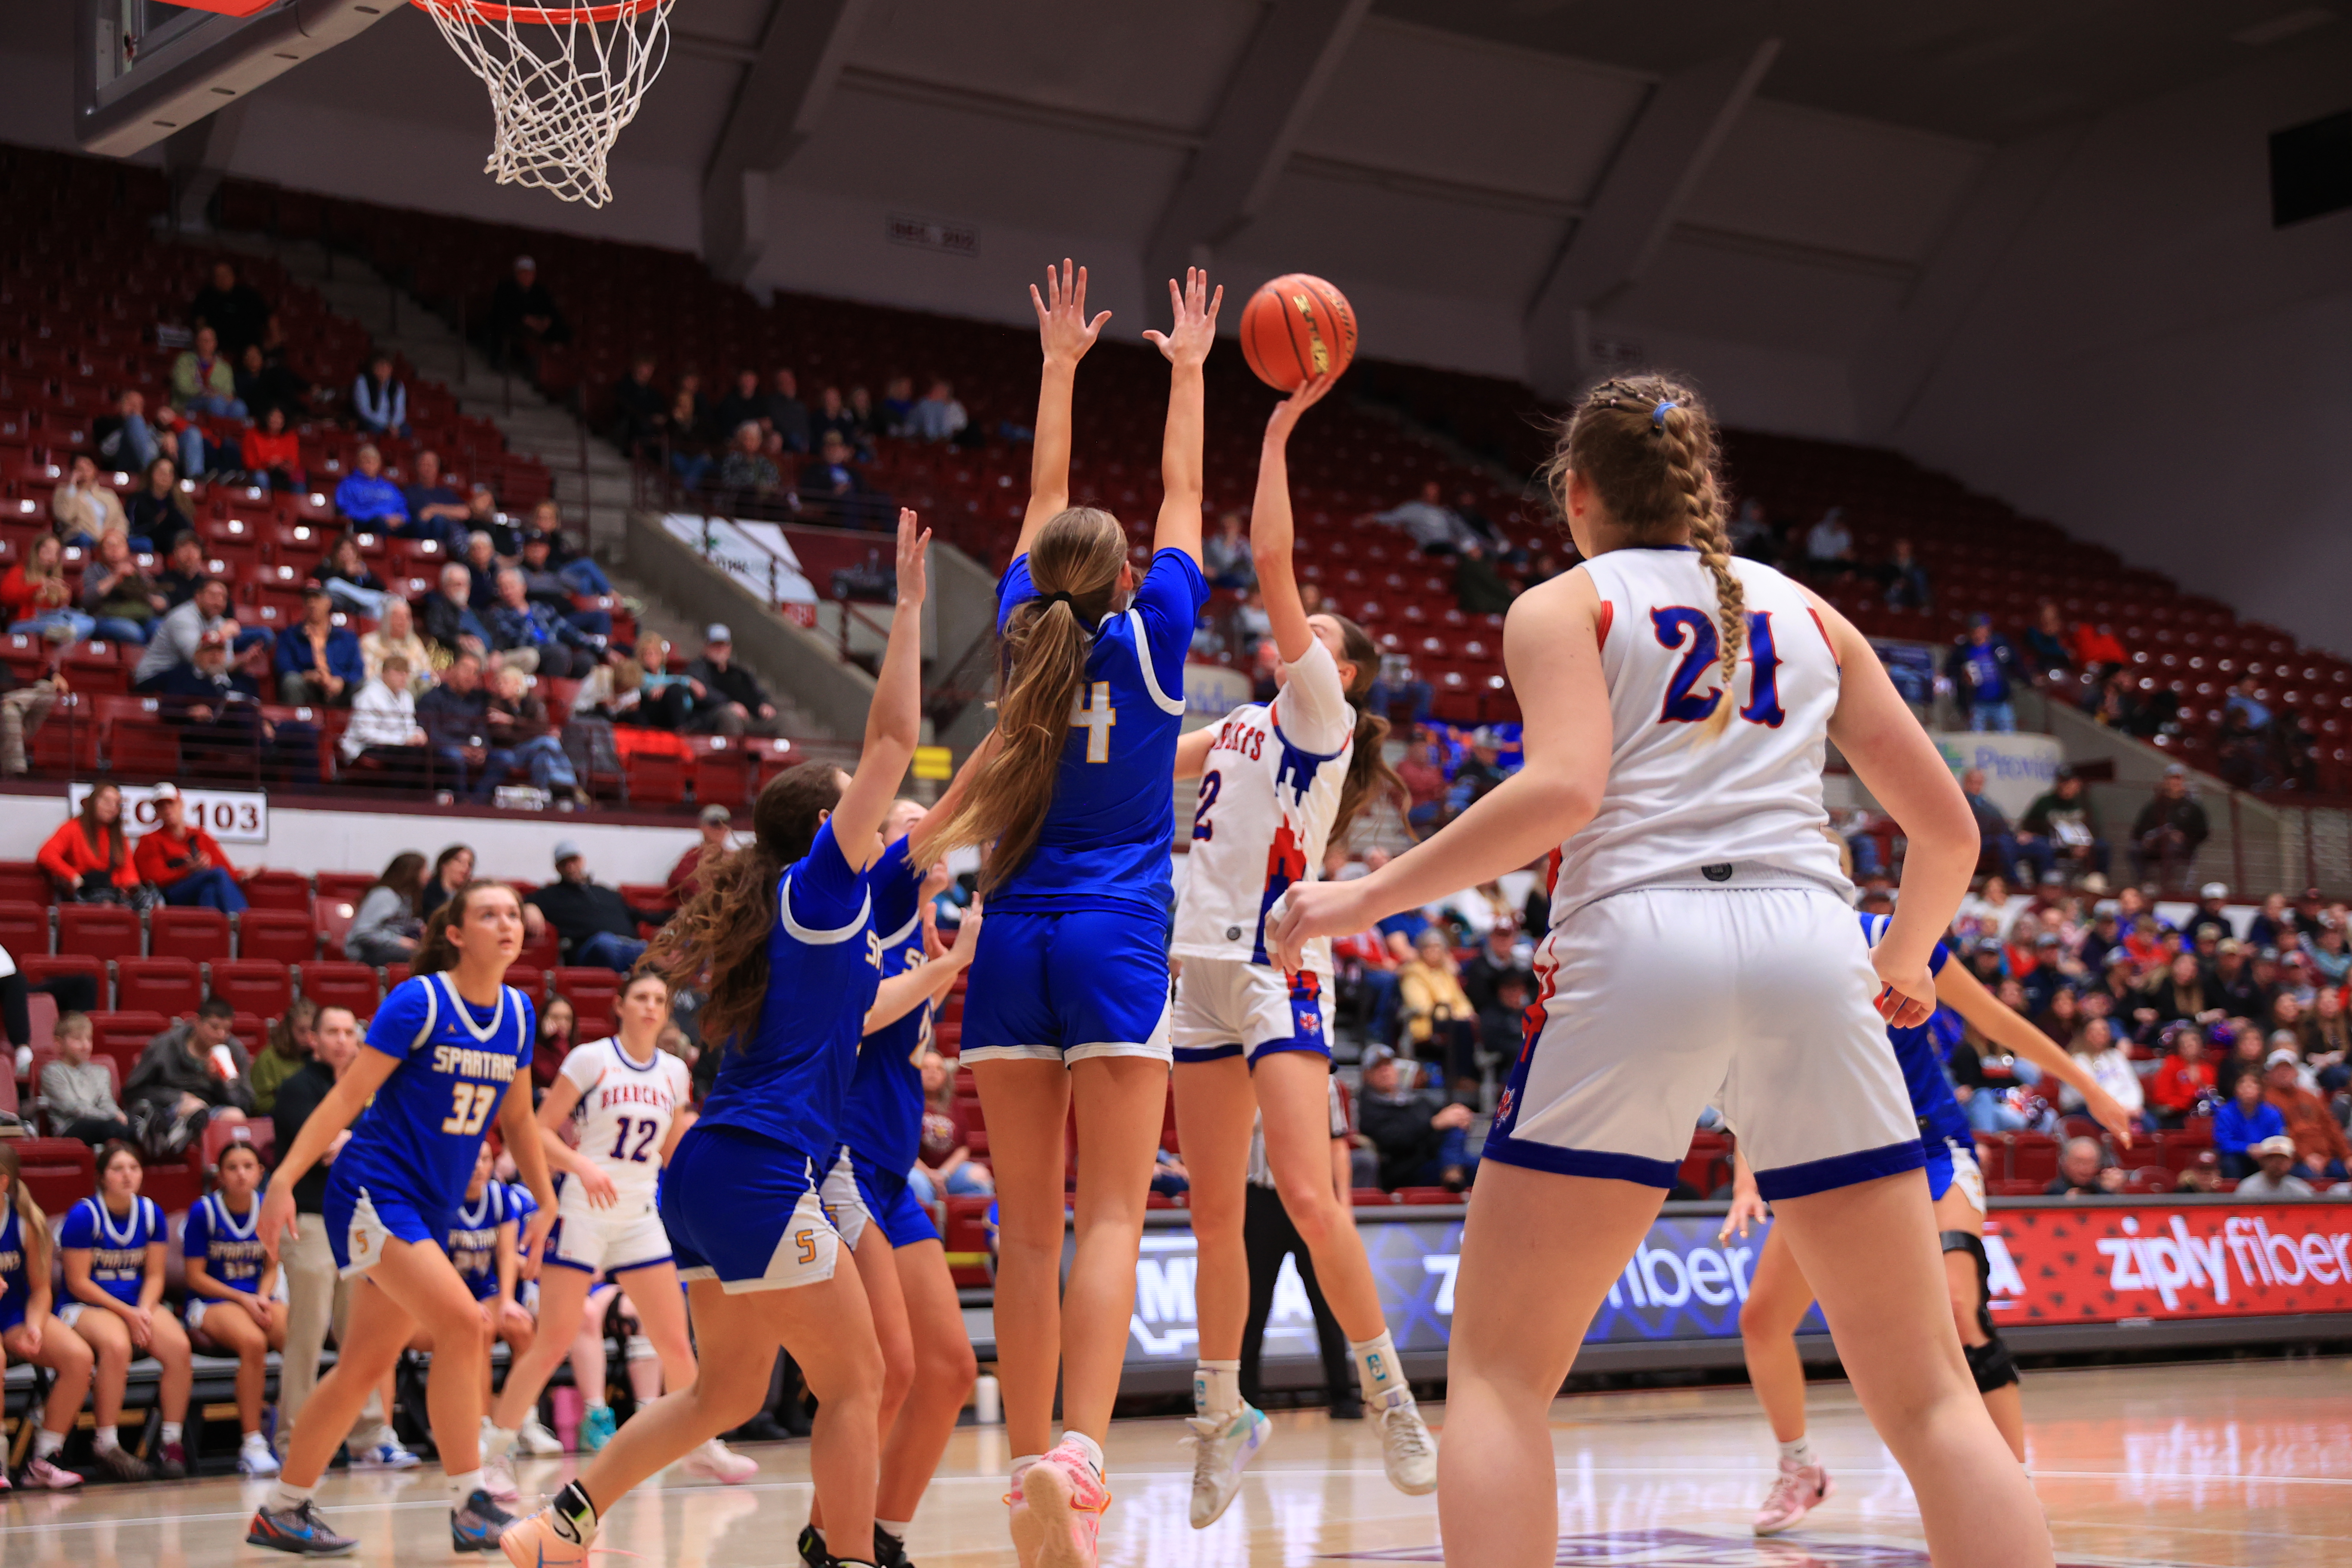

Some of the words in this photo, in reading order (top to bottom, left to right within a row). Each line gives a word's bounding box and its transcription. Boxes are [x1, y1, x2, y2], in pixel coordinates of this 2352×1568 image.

[1650, 605, 1786, 729] 21
[1068, 680, 1116, 764] 4
[192, 801, 257, 830] 103
[1193, 769, 1221, 842] 2
[432, 1044, 519, 1084] SPARTANS
[441, 1081, 497, 1136] 33
[609, 1116, 658, 1162] 12
[2096, 1214, 2231, 1311] ziply
[2224, 1216, 2352, 1287] fiber
